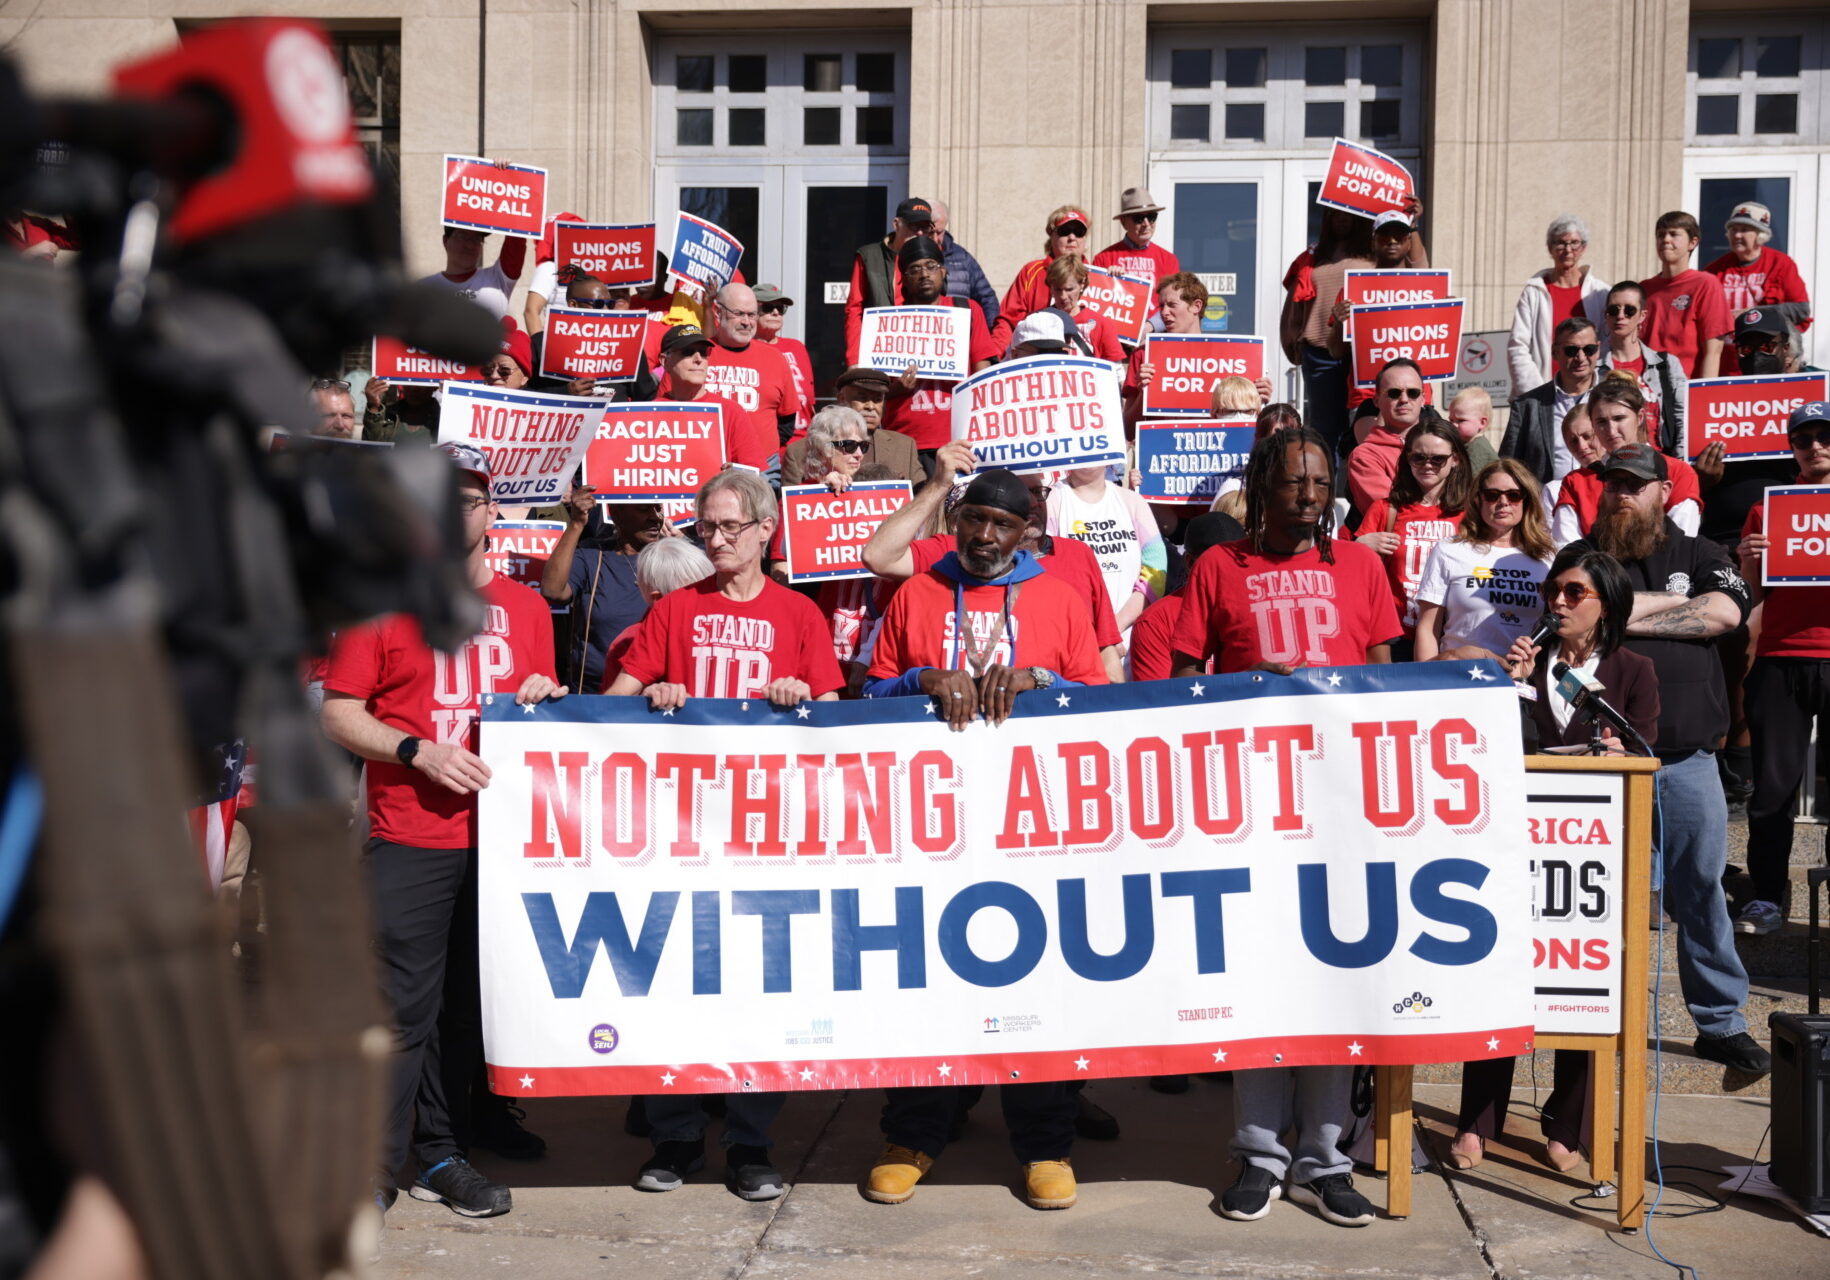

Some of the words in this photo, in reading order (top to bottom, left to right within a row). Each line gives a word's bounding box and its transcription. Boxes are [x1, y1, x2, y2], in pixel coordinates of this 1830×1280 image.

[1344, 160, 1406, 190] UNIONS
[461, 176, 531, 200] UNIONS
[1336, 175, 1372, 197] FOR
[1373, 187, 1405, 207] ALL
[456, 193, 493, 212] FOR
[497, 199, 532, 217] ALL
[572, 241, 642, 256] UNIONS
[701, 229, 731, 259] TRULY
[569, 257, 607, 272] FOR
[611, 256, 645, 271] ALL
[1118, 256, 1156, 272] STAND
[1202, 275, 1234, 292] NTER
[1082, 286, 1136, 308] NIONS
[1363, 290, 1433, 304] UNIONS
[1077, 300, 1101, 313] OR
[1104, 306, 1134, 325] ALL
[554, 319, 641, 339] RACIALLY
[877, 315, 954, 336] NOTHING
[1372, 323, 1449, 344] UNIONS
[575, 340, 620, 356] JUST
[872, 335, 929, 356] ABOUT
[934, 338, 956, 357] US
[1369, 346, 1413, 363] FOR
[1417, 343, 1449, 361] ALL
[396, 356, 466, 375] HIRING
[563, 356, 624, 374] HIRING
[871, 356, 935, 370] WITHOUT
[938, 360, 956, 371] US
[1166, 357, 1247, 374] UNIONS
[705, 365, 760, 388] STAND
[1161, 377, 1205, 392] FOR
[971, 370, 1097, 413] NOTHING
[1708, 398, 1805, 418] UNIONS
[469, 403, 585, 444] NOTHING
[595, 420, 713, 440] RACIALLY
[967, 404, 1058, 442] ABOUT
[1066, 402, 1105, 432] US
[1704, 422, 1755, 438] FOR
[973, 437, 1073, 463] WITHOUT
[1079, 434, 1109, 451] US
[1173, 431, 1227, 452] TRULY
[480, 446, 542, 478] BOUT
[538, 446, 573, 475] US
[624, 444, 687, 463] JUST
[1149, 453, 1250, 474] AFFORDABLE
[535, 479, 559, 493] US
[613, 467, 699, 487] HIRING
[1164, 476, 1224, 495] HOUSIN
[795, 497, 905, 521] RACIALLY
[1084, 519, 1117, 531] STOP
[1405, 521, 1455, 541] STAND
[488, 536, 558, 554] IALLY
[1067, 529, 1137, 543] EVICTIONS
[815, 544, 865, 565] HIRI
[1089, 542, 1127, 555] NOW!
[484, 558, 530, 576] UST
[1489, 568, 1531, 579] STOP
[1245, 569, 1336, 601] STAND
[1466, 577, 1541, 592] EVICTION
[1489, 590, 1537, 609] NOW!
[692, 614, 775, 652] STAND
[1250, 597, 1341, 665] UP
[433, 634, 514, 708] UP
[691, 646, 772, 698] UP
[523, 749, 966, 868] NOTHING
[995, 723, 1324, 858] ABOUT
[1352, 718, 1490, 838] US
[1527, 817, 1611, 845] RICA
[520, 866, 1251, 999] WITHOUT
[1297, 858, 1498, 969] US
[1178, 1008, 1206, 1021] STAND
[1208, 1007, 1219, 1019] UP
[1221, 1006, 1233, 1018] KC
[1548, 1004, 1610, 1013] #FIGHTFOR15
